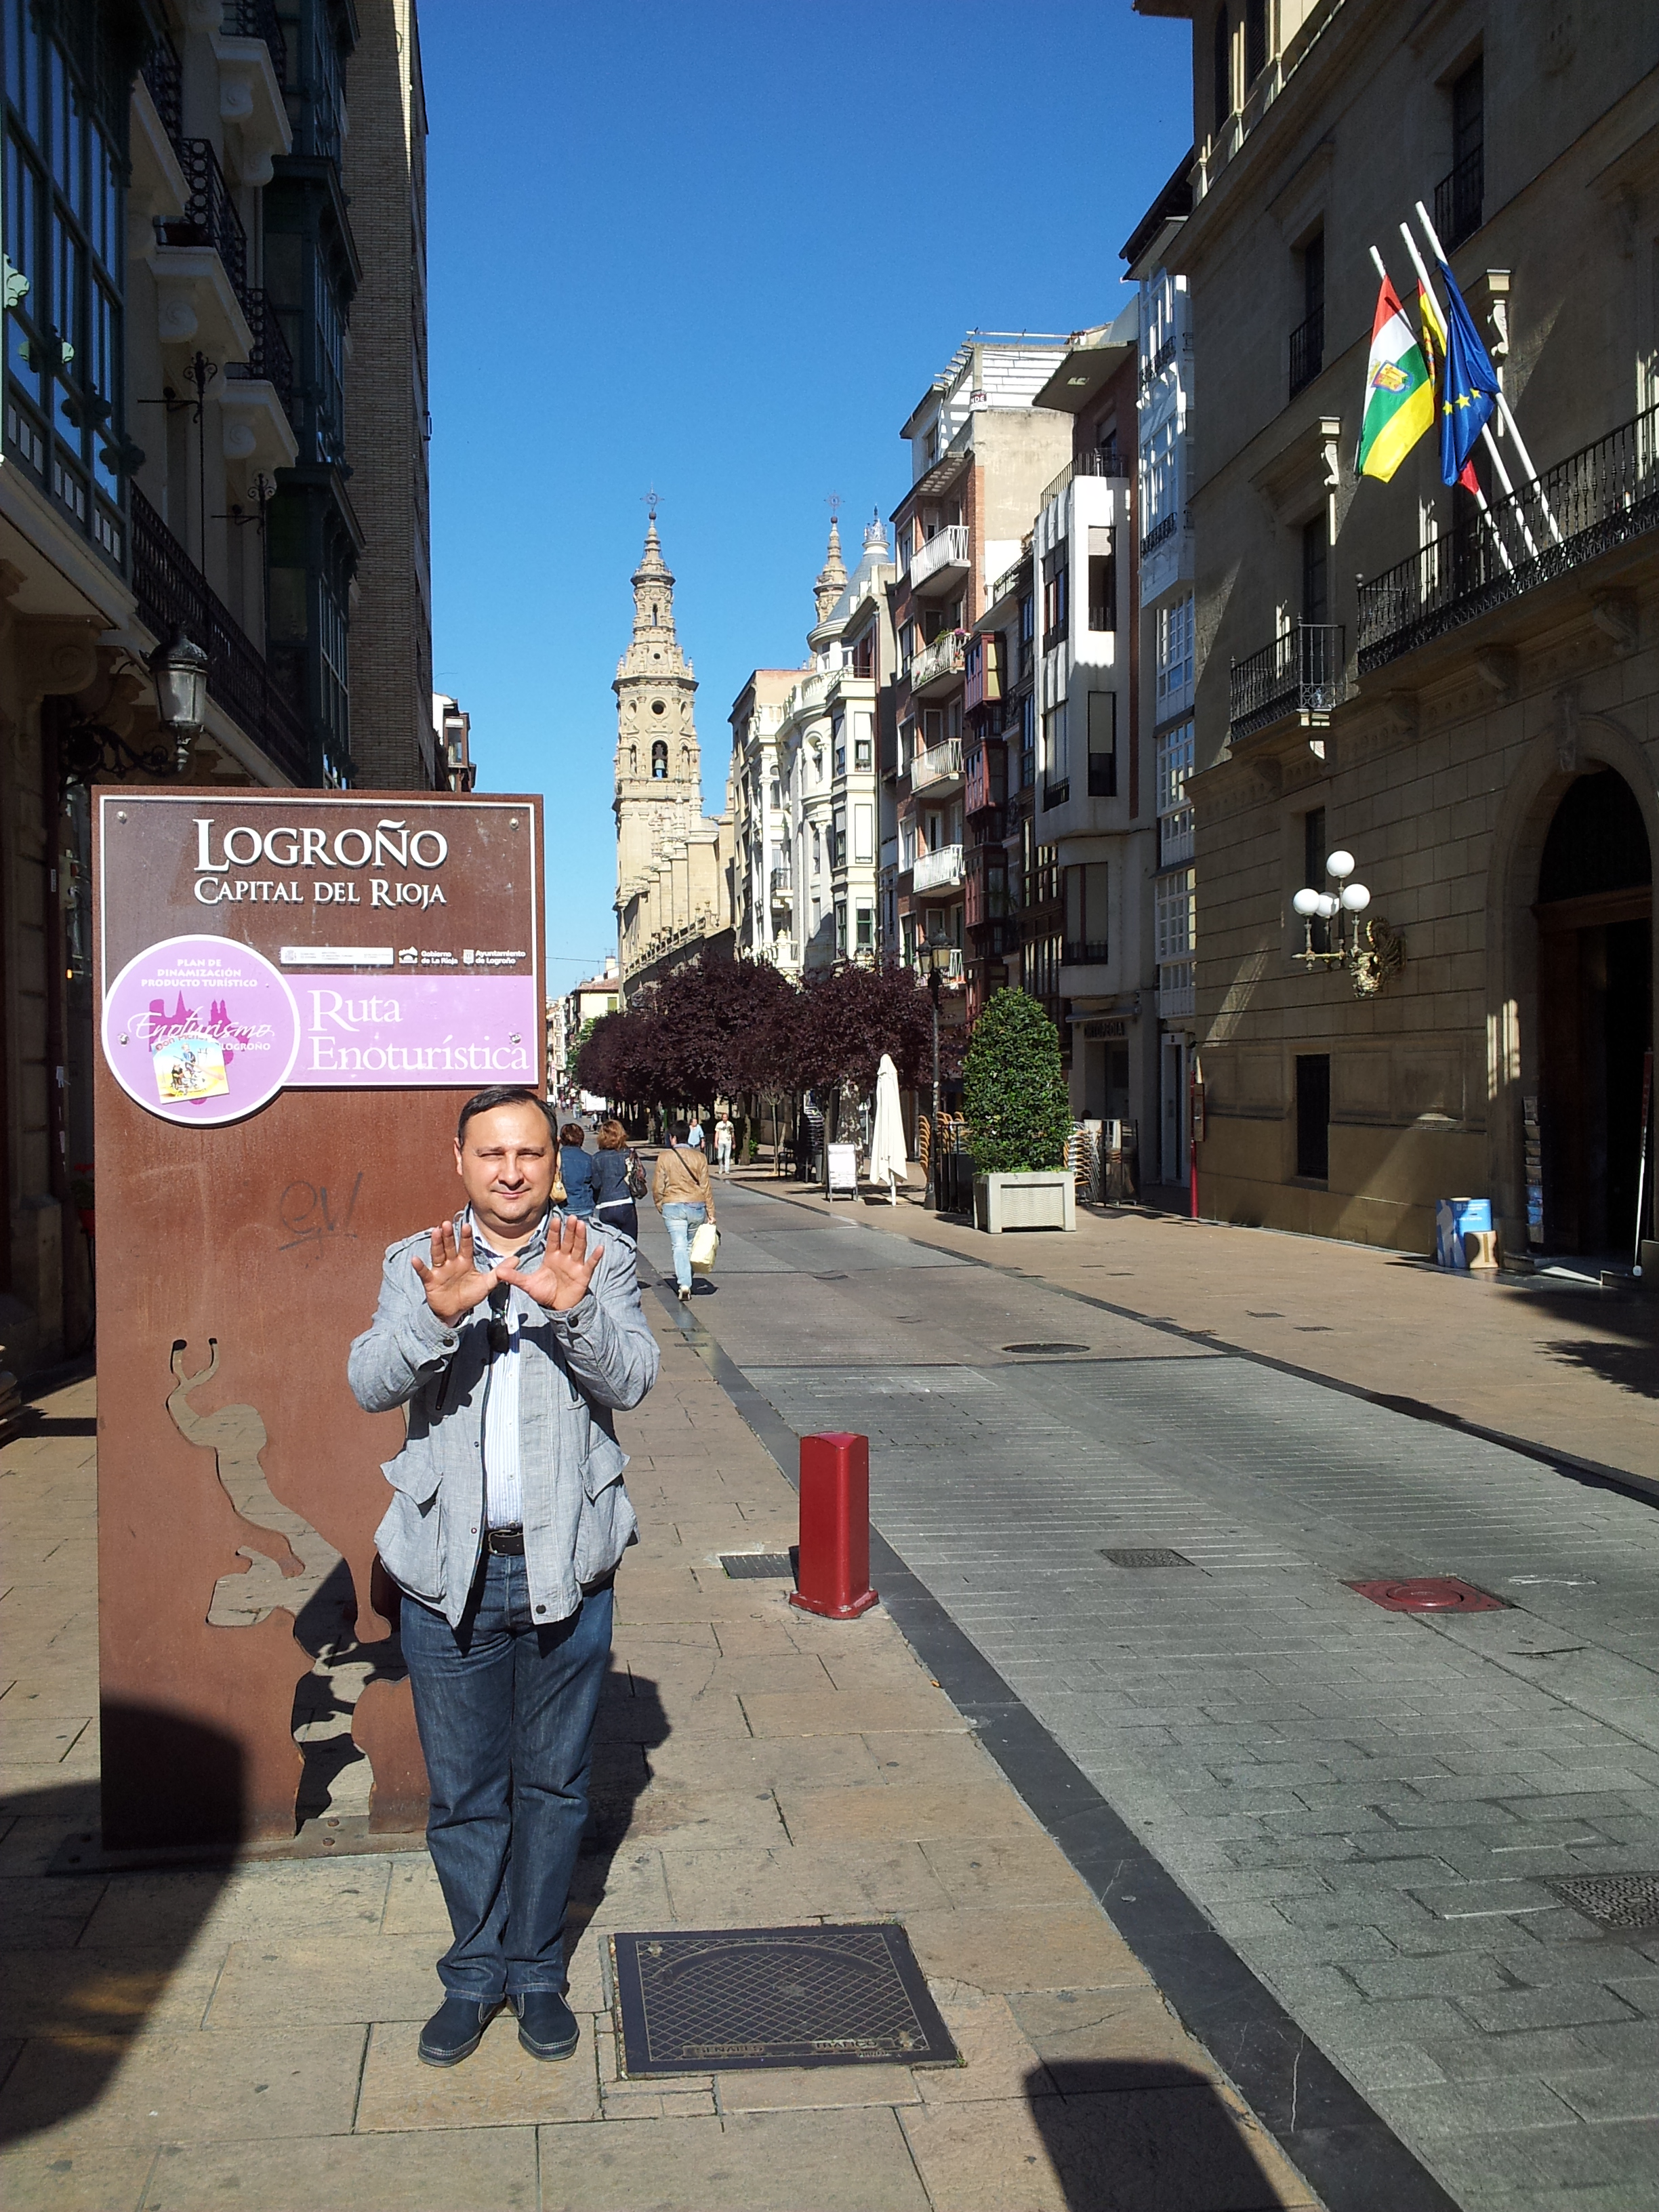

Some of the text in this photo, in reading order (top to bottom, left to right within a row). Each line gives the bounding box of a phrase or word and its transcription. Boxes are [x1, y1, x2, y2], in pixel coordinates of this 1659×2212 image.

[192, 819, 448, 872] LOGROÑO
[194, 877, 447, 910] CAPITAL DEL RIOJA
[476, 950, 527, 958] Ayuntamiento
[442, 958, 459, 966] Rioja
[486, 957, 516, 966] Logroño
[157, 967, 241, 977] DINAMIZACIÓN
[141, 977, 258, 987] PRODUCTO TURÍSTICO
[307, 989, 403, 1032] Ruta
[127, 1006, 275, 1042] Enoturismo
[221, 1042, 271, 1051] LOGROÑO
[307, 1034, 531, 1071] Enoturística
